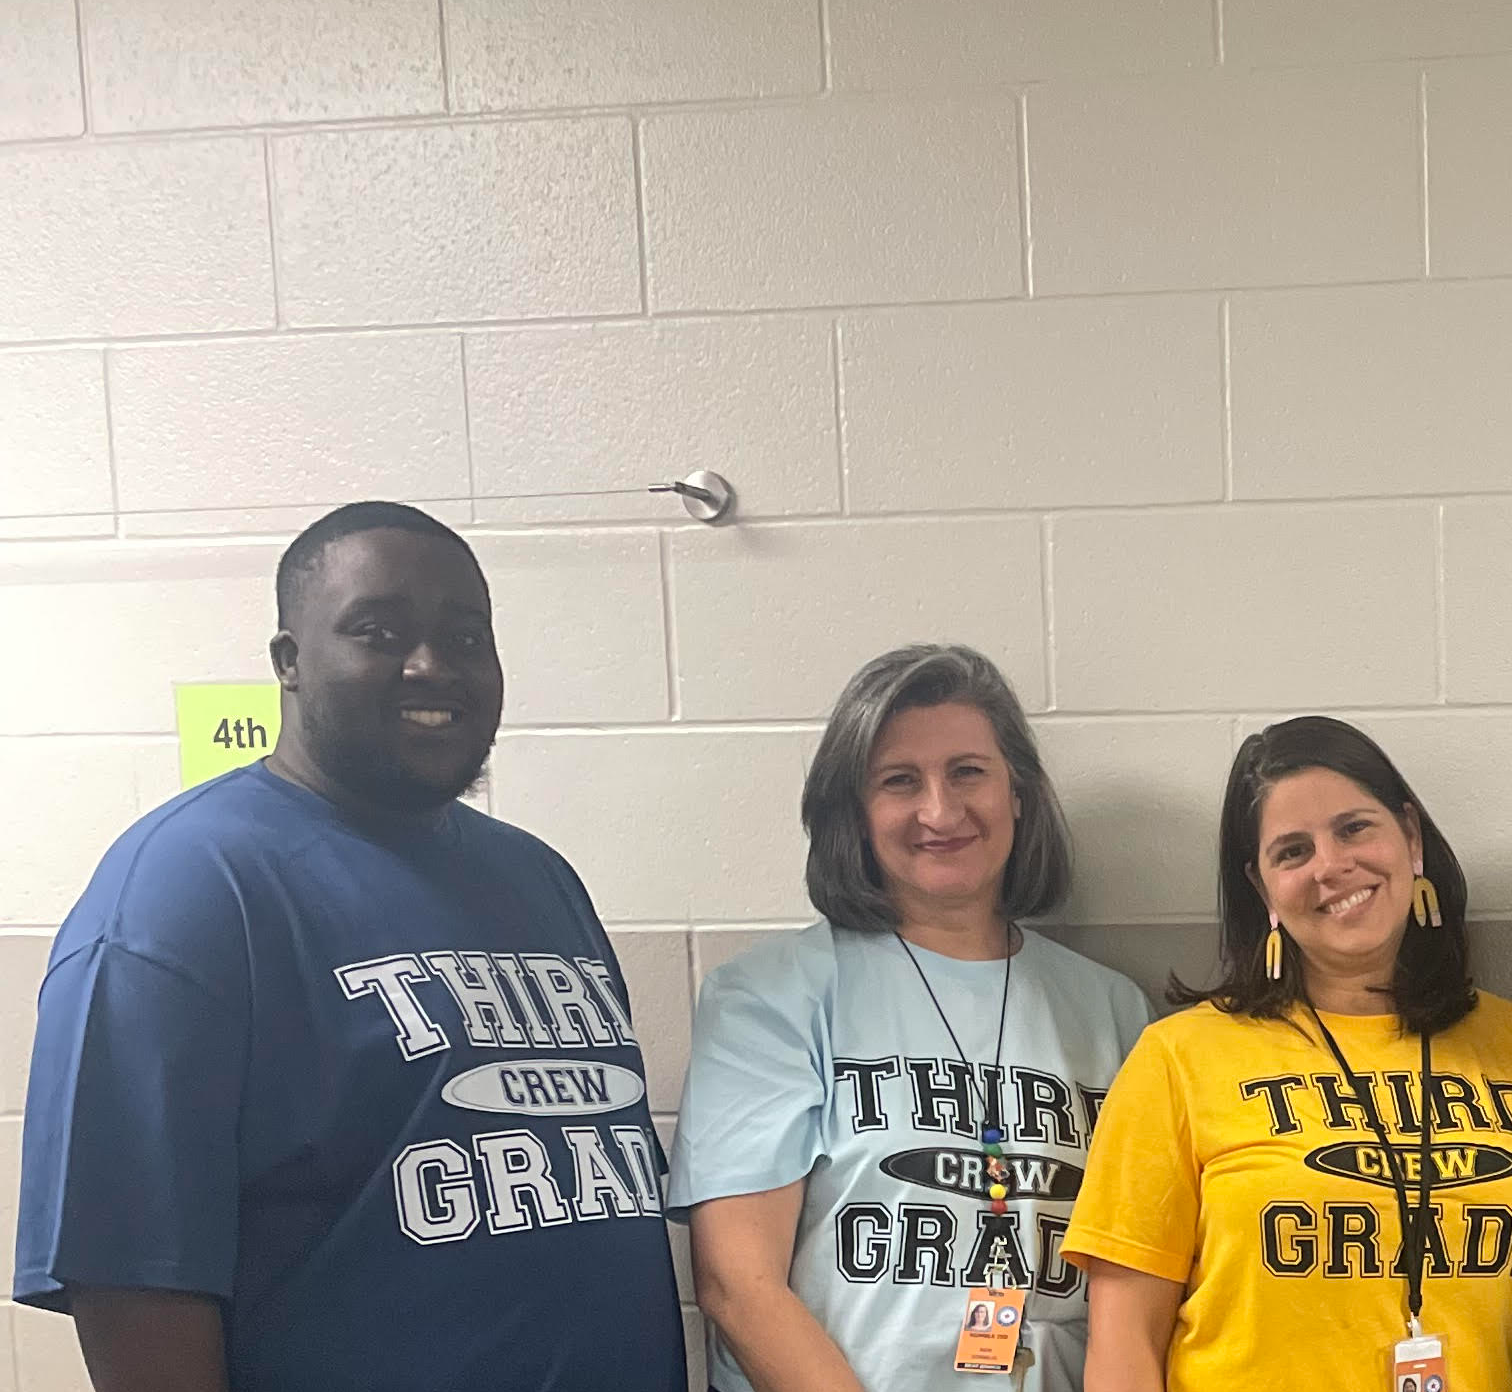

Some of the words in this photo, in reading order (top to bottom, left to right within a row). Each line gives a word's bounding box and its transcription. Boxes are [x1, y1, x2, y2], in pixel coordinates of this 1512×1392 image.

[213, 718, 267, 749] 4th
[499, 1066, 612, 1107] CREW
[393, 1125, 663, 1245] GRAD
[935, 1152, 1059, 1195] CRW
[835, 1203, 1090, 1298] GRAD
